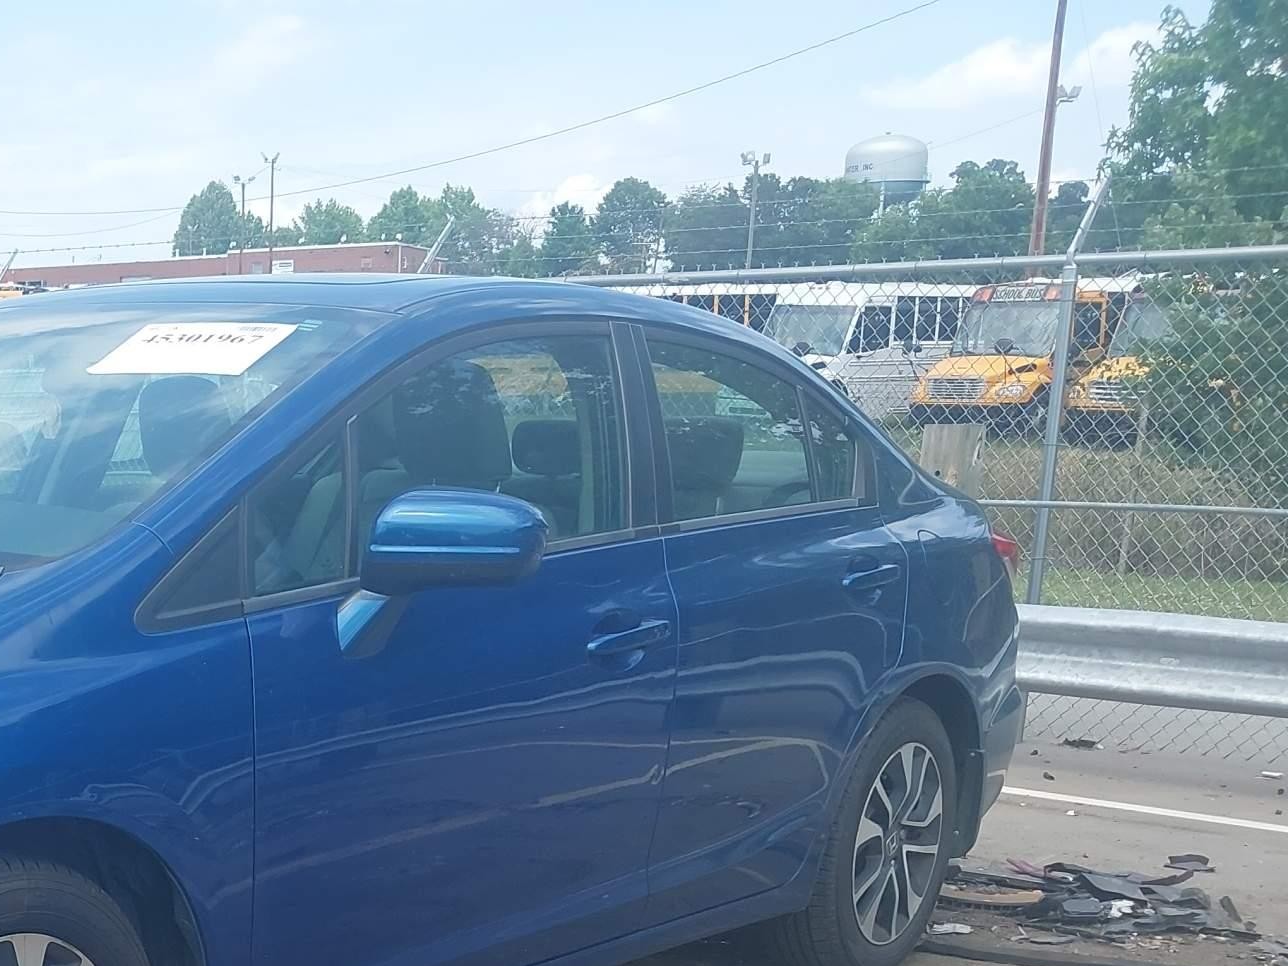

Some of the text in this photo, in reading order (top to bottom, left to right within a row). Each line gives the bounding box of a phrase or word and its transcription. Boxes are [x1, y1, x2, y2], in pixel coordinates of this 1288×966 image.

[993, 287, 1043, 299] SCHOOL BUS
[142, 333, 264, 344] 45301967
